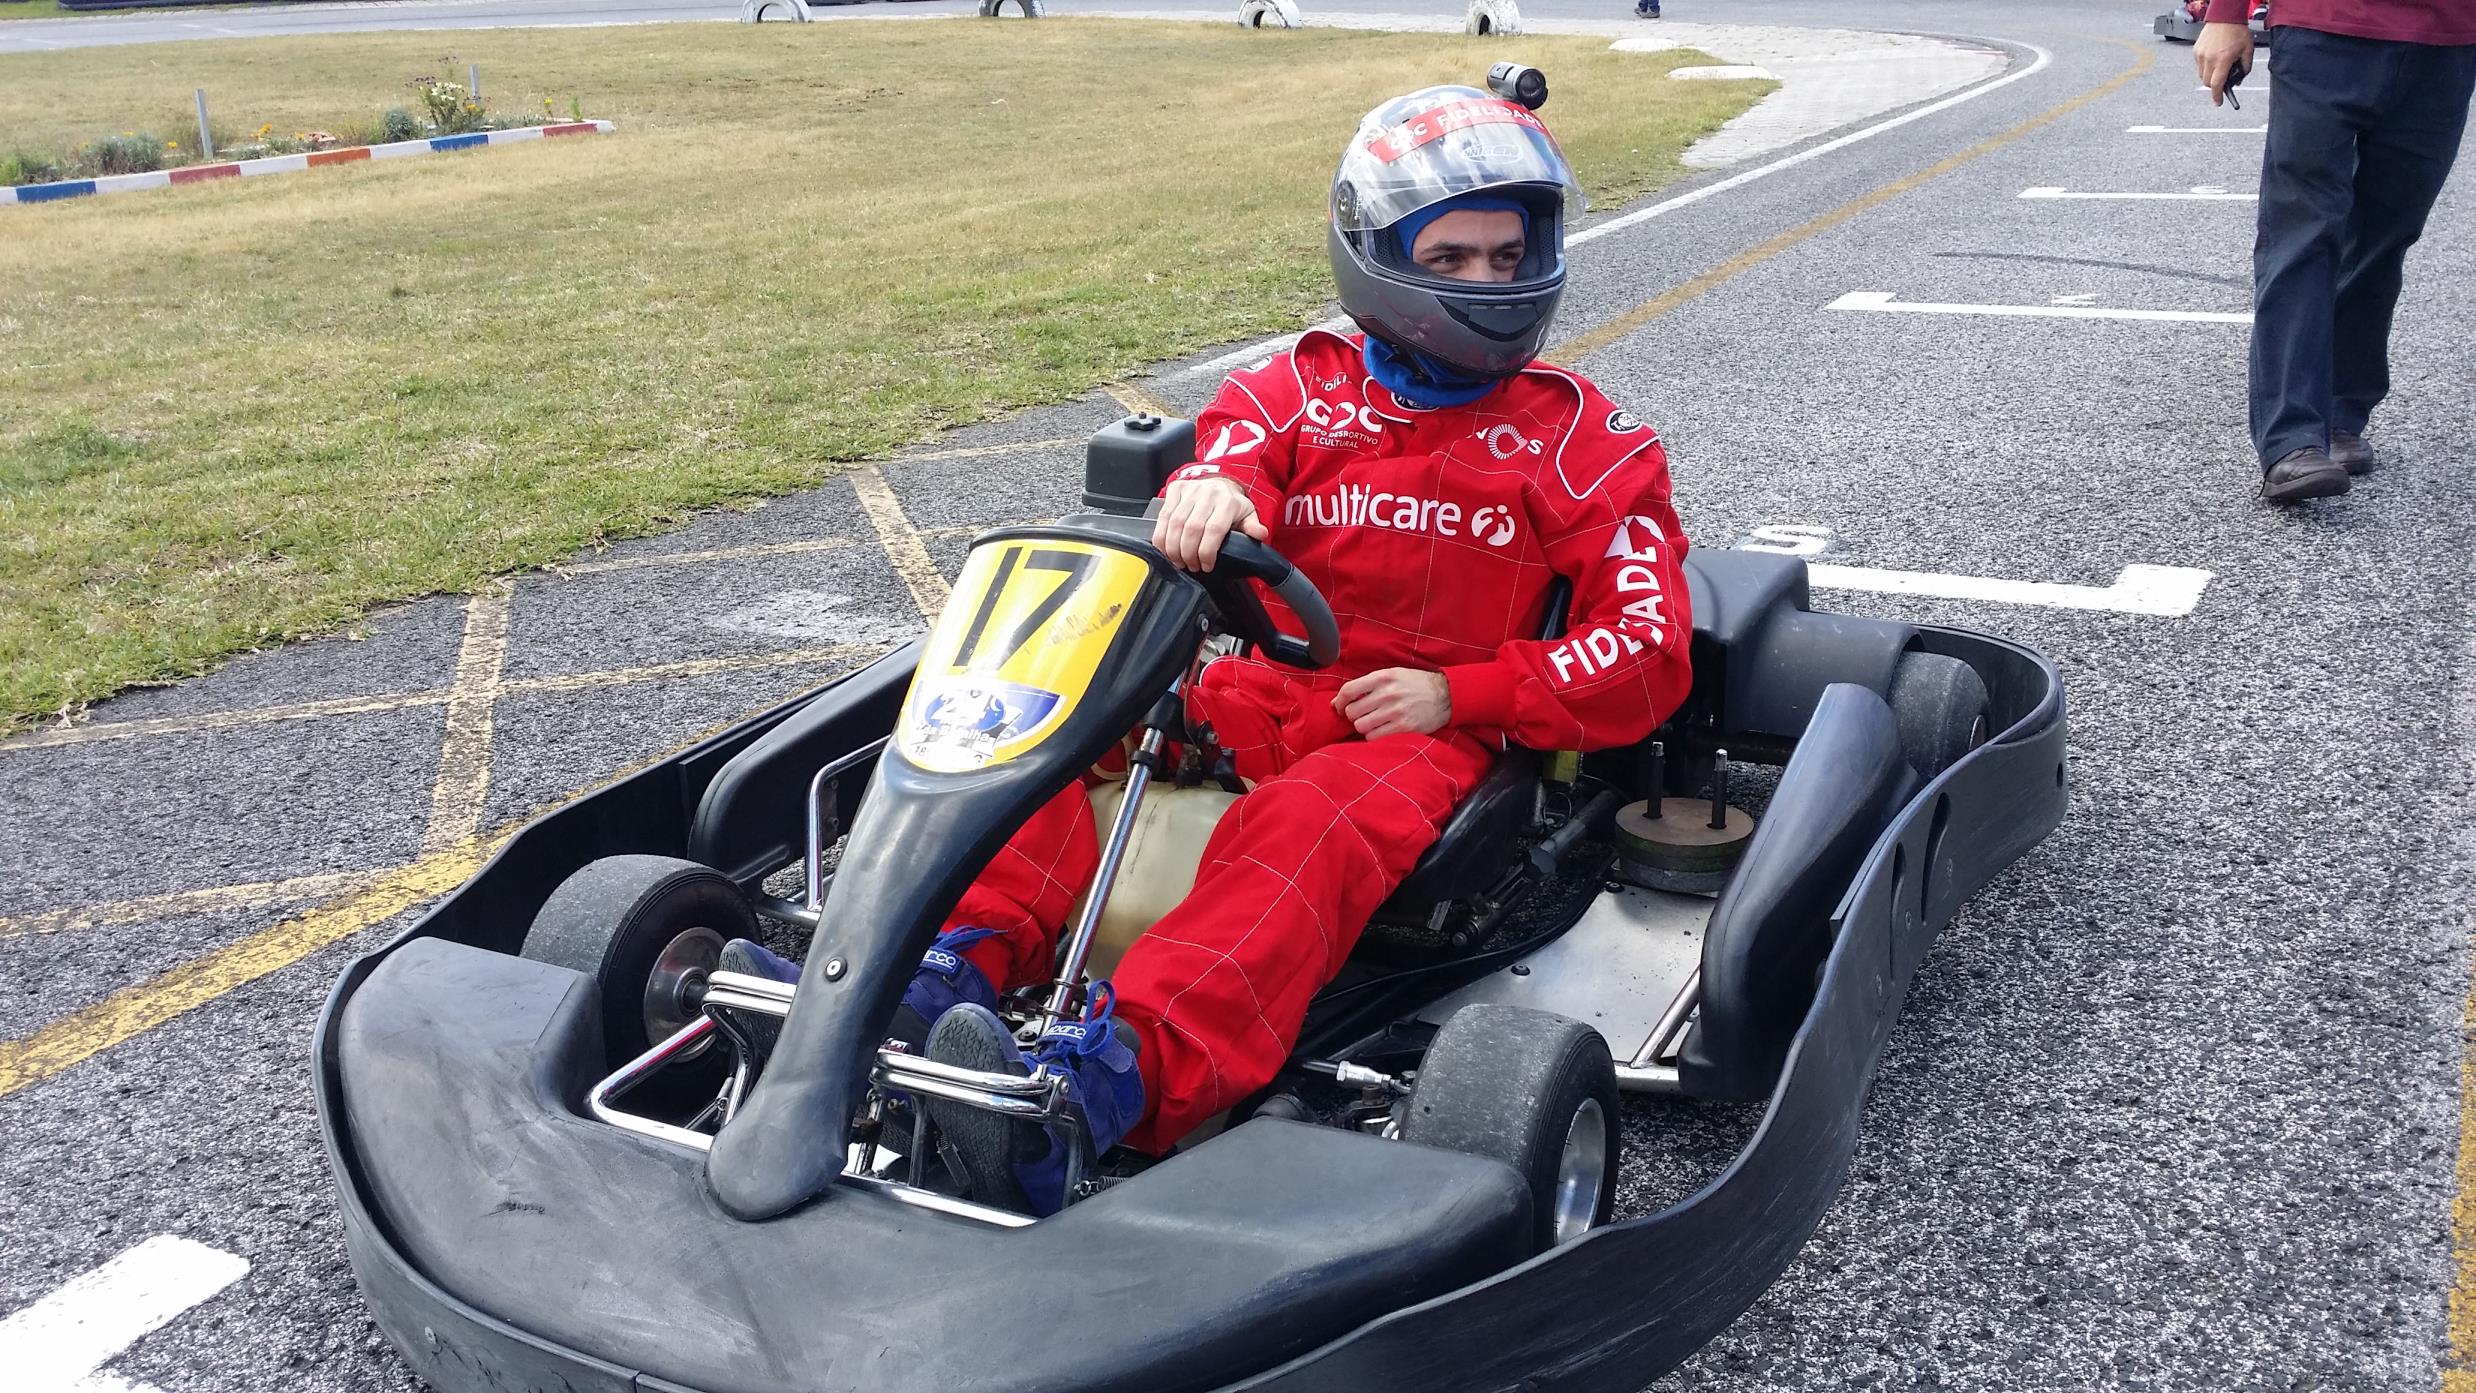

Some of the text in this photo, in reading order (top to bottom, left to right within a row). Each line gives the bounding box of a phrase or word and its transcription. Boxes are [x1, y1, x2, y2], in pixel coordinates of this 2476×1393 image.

[1301, 425, 1378, 445] GRUPO DESPORTIVO
[1320, 438, 1358, 448] CULTURAL
[1284, 483, 1462, 536] multicare
[953, 546, 1101, 671] 17
